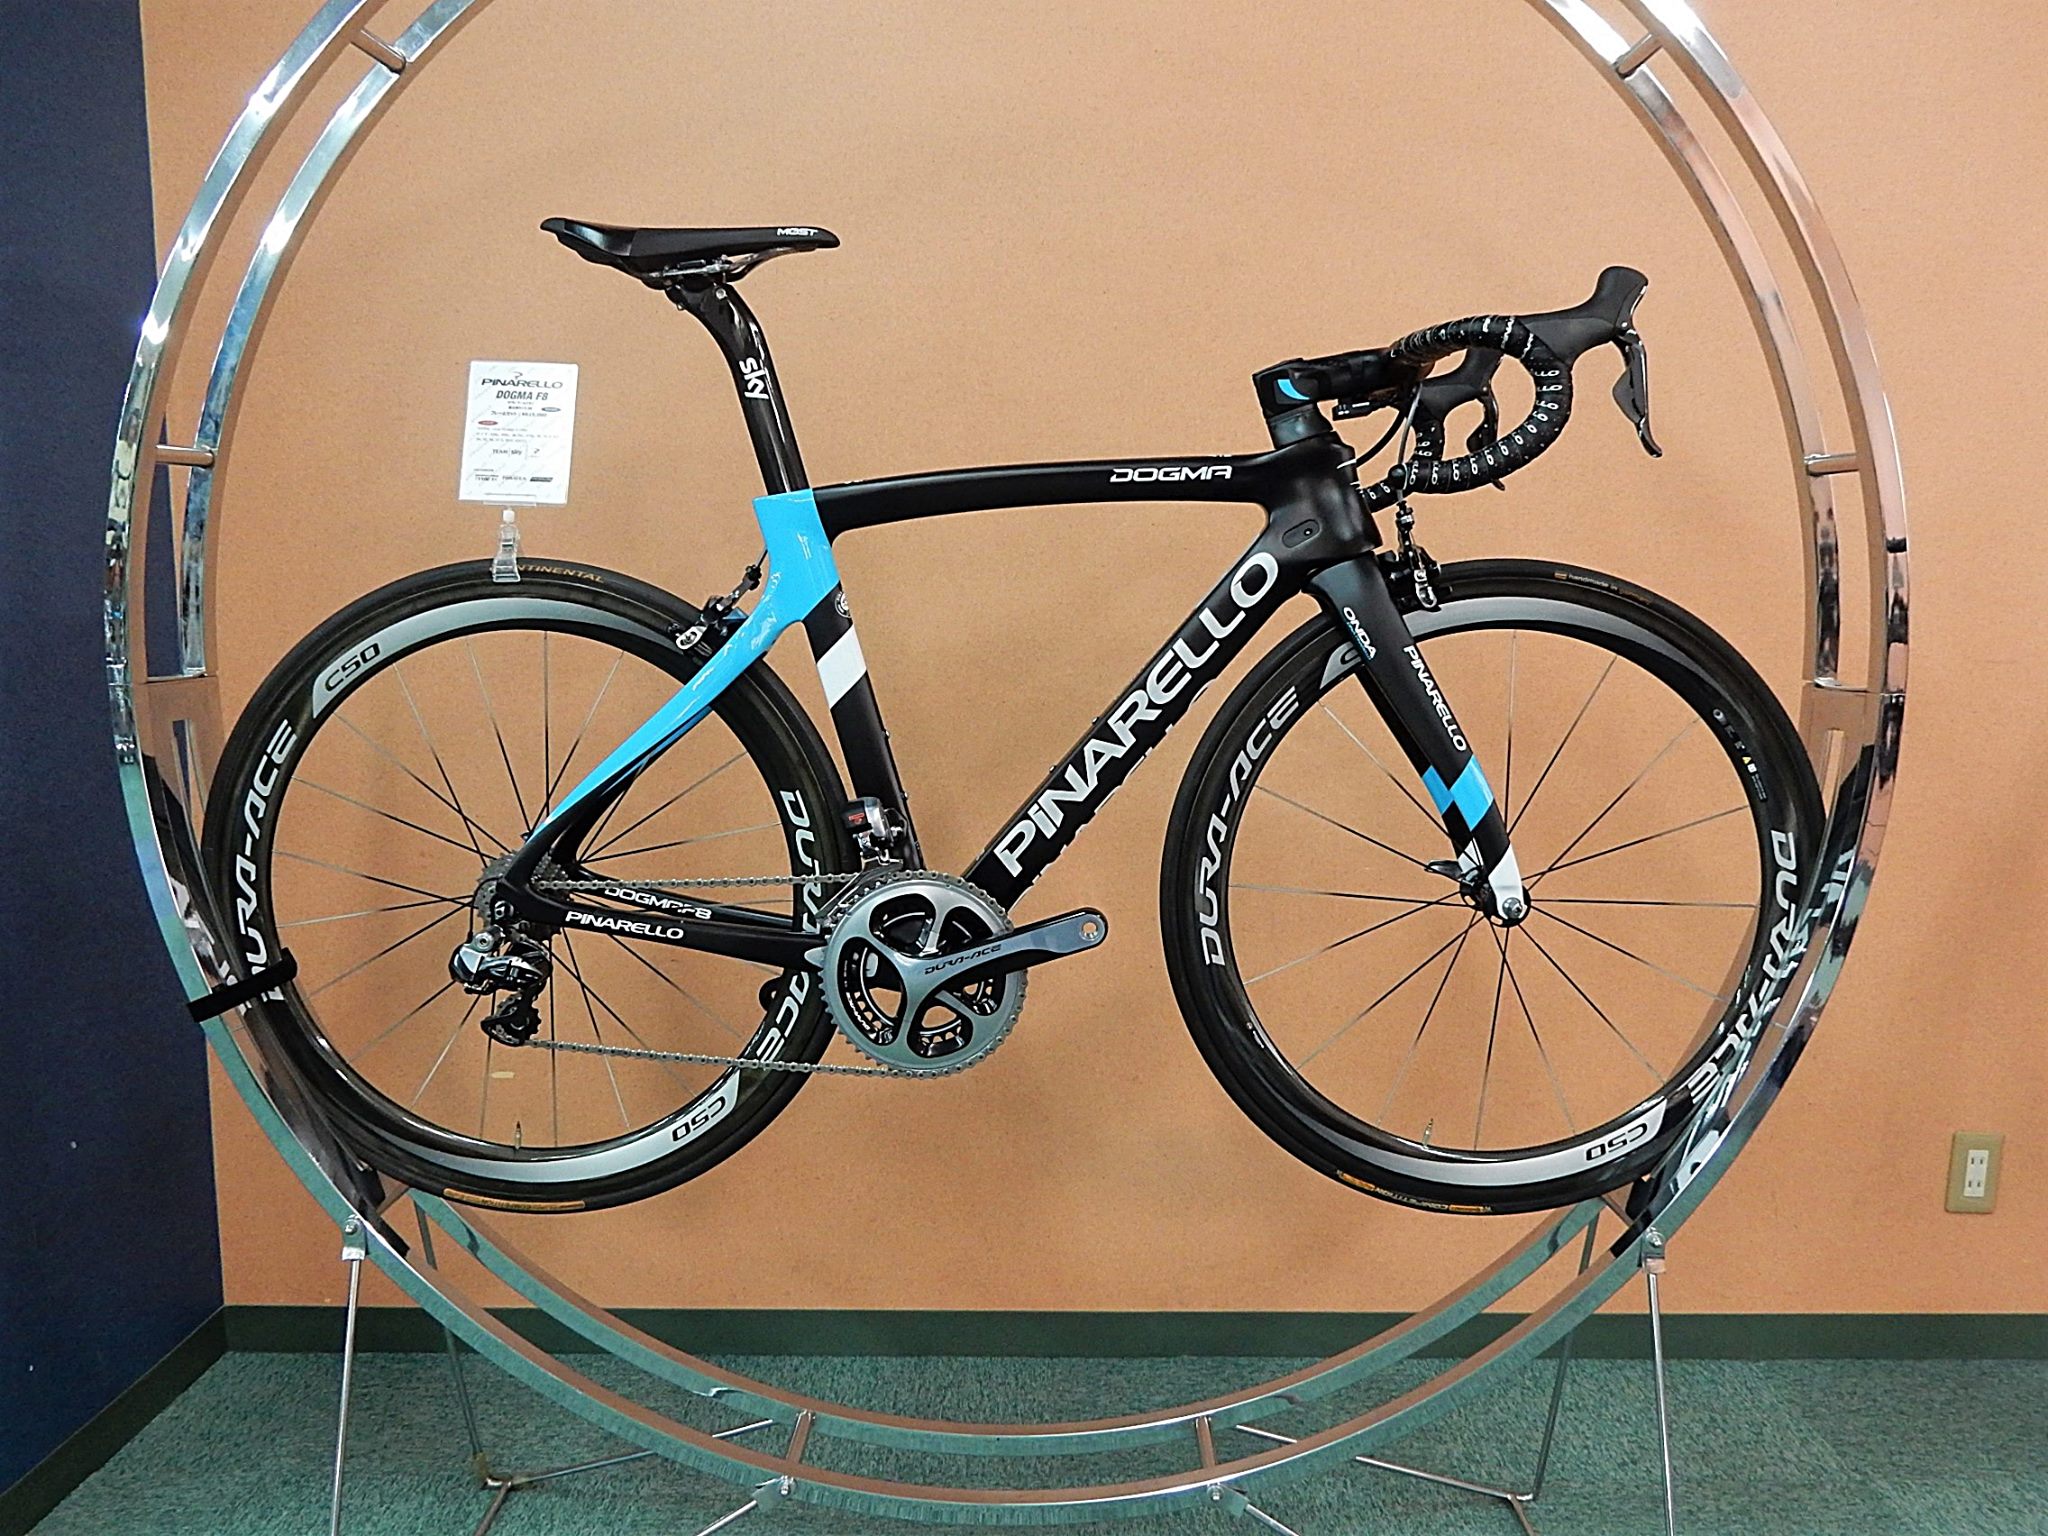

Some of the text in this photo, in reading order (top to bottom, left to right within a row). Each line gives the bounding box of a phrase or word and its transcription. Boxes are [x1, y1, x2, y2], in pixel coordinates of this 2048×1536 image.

[777, 228, 818, 236] MOST
[481, 378, 563, 389] PINARELLO
[496, 390, 549, 400] DOGMA F8
[739, 357, 769, 399] sky
[1110, 465, 1232, 483] DOGMA
[1343, 606, 1377, 660] ONDA
[325, 643, 380, 691] C50
[994, 552, 1279, 877] PINARELLO
[1403, 645, 1467, 751] PINARELLO
[1199, 686, 1299, 966] DURA-ACE
[565, 911, 684, 939] PINARELLO
[925, 944, 1001, 974] DURA-ACE
[672, 1096, 726, 1141] C50
[1586, 1123, 1648, 1161] C50
